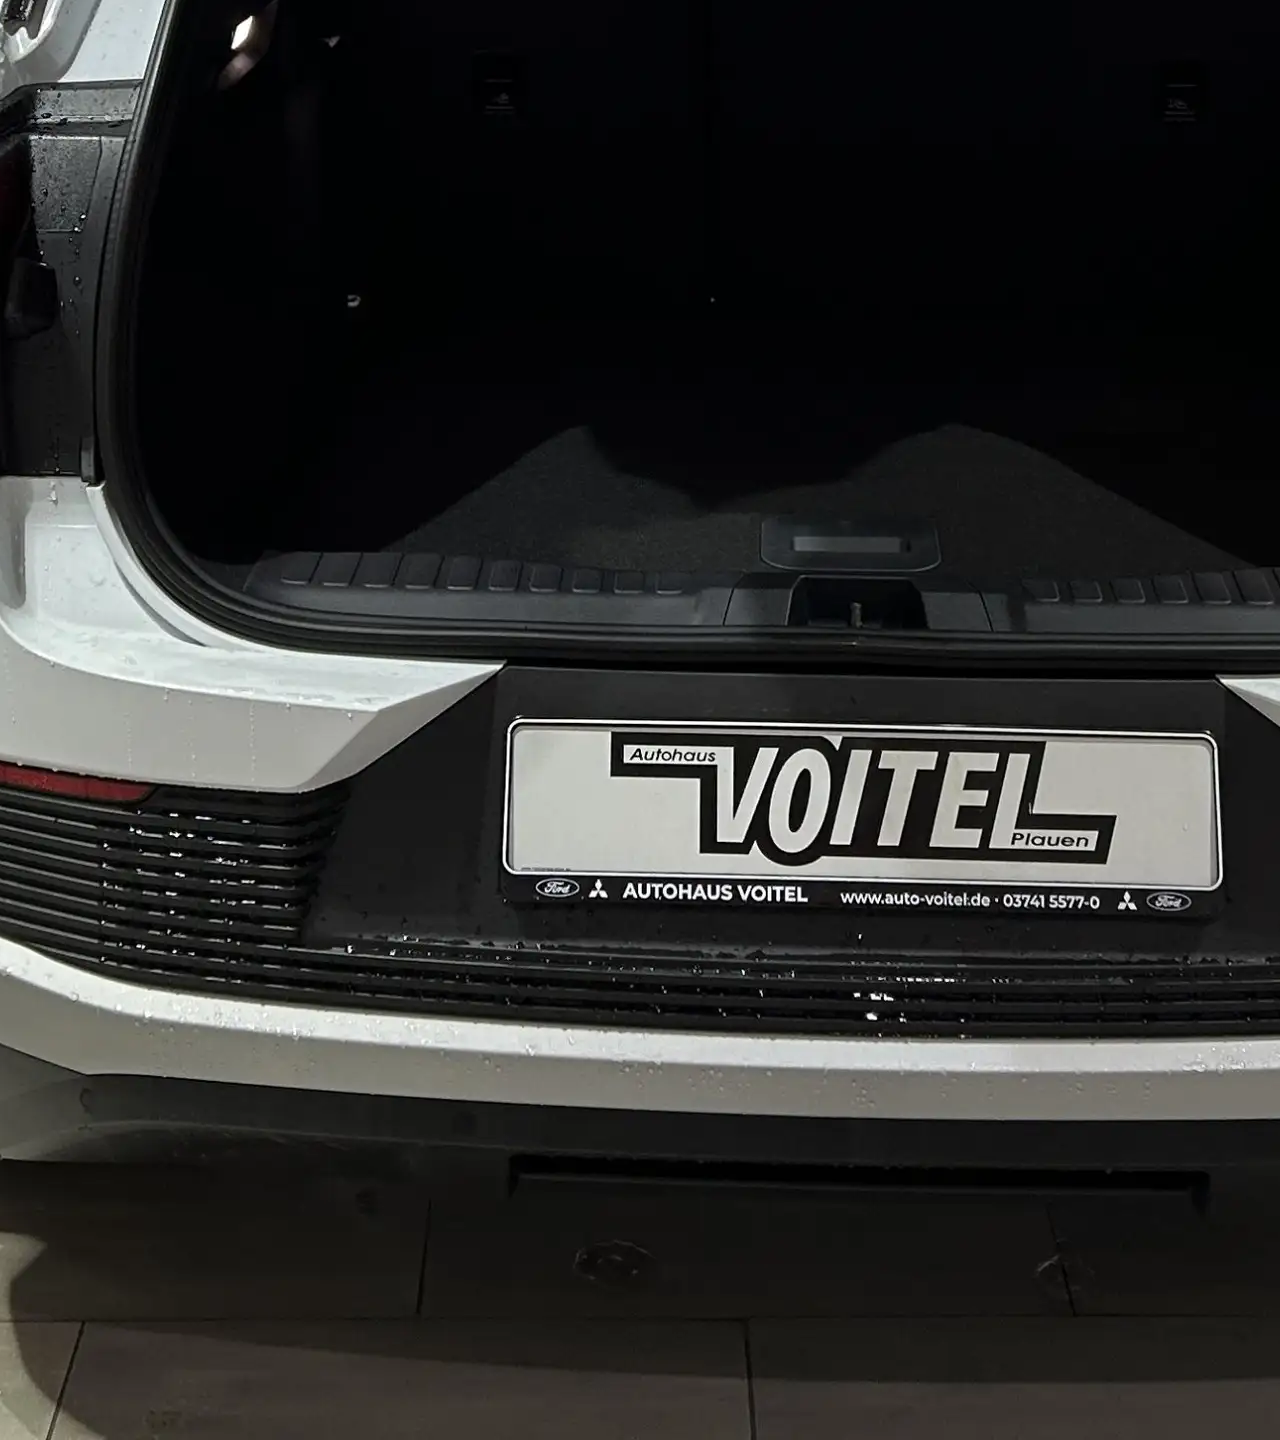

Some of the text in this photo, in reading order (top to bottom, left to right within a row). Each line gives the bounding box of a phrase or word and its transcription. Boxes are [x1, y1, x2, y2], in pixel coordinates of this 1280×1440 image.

[629, 747, 717, 763] Autohaus
[710, 743, 1038, 858] VOITEL
[1010, 832, 1090, 848] Plauen
[622, 882, 809, 903] AUTOHAUS VOITEL
[840, 891, 1101, 909] www.auto-voitel.de 03741 5577-0
